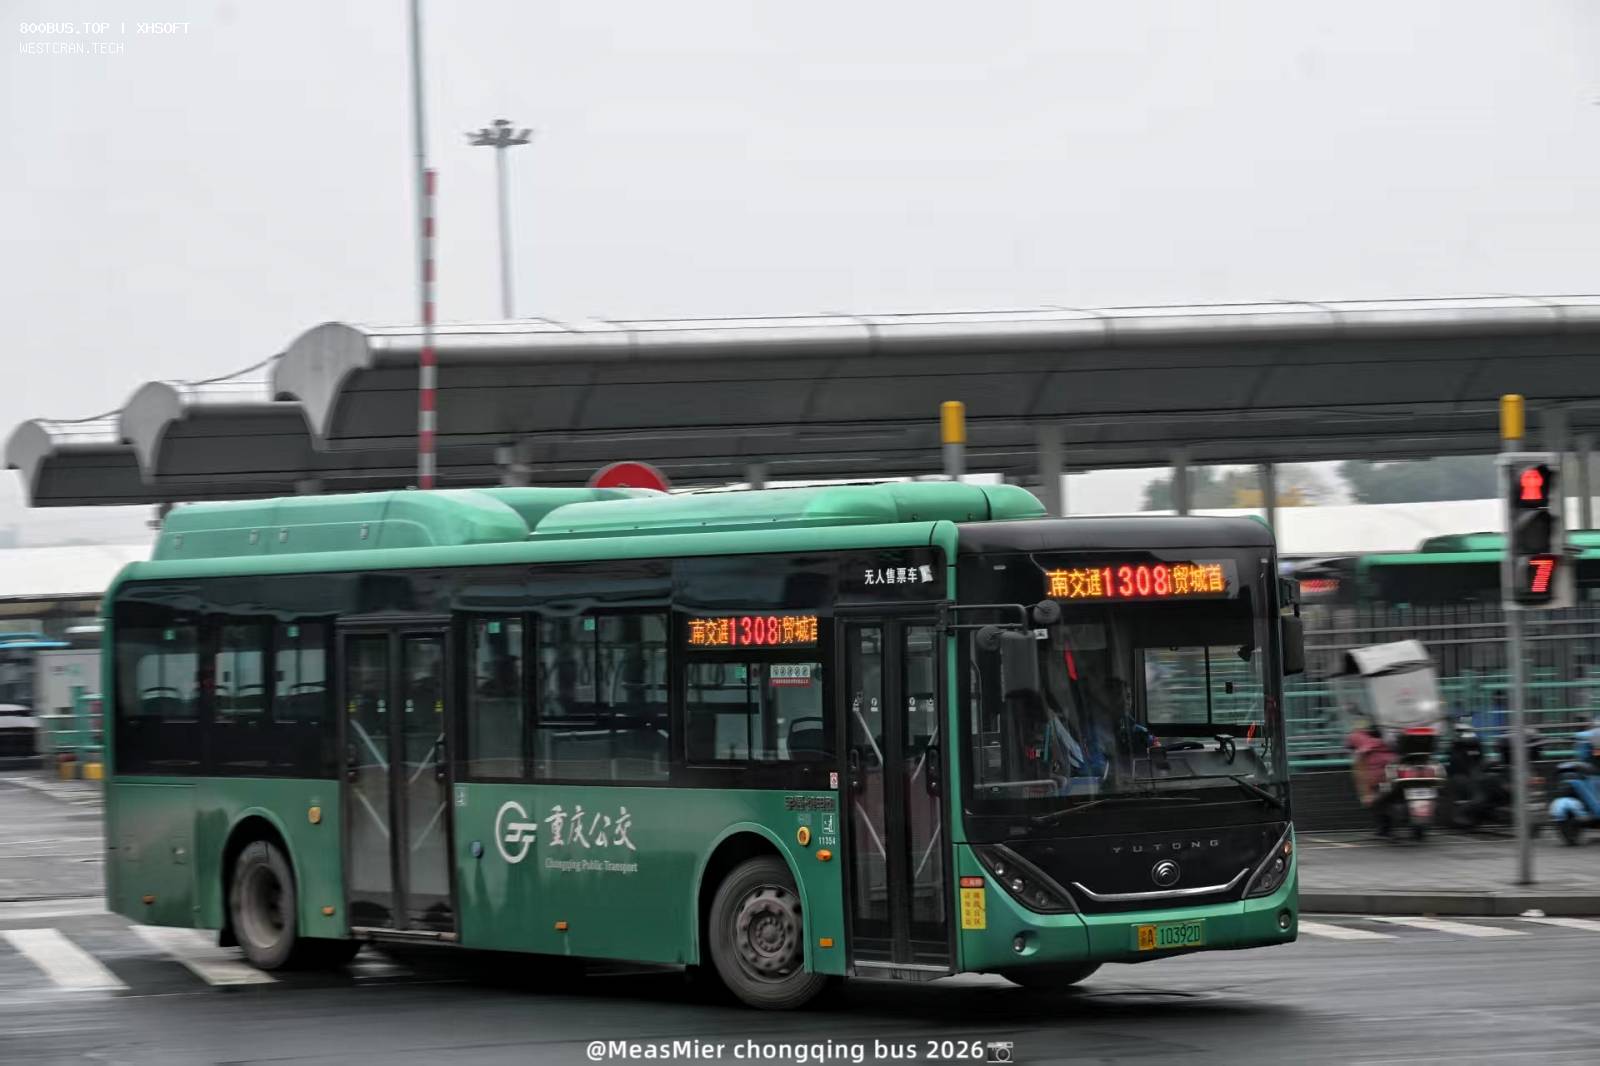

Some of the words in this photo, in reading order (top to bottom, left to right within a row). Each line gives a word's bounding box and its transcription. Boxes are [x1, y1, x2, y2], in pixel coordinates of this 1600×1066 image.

[864, 567, 918, 585] 无人售票车
[1046, 568, 1102, 597] 南交通
[1102, 565, 1168, 597] 1308
[1528, 560, 1554, 592] 7
[688, 618, 729, 645] 南交通
[730, 616, 778, 645] 1308
[544, 804, 637, 850] 重庆公交
[1112, 839, 1220, 853] YUTONG
